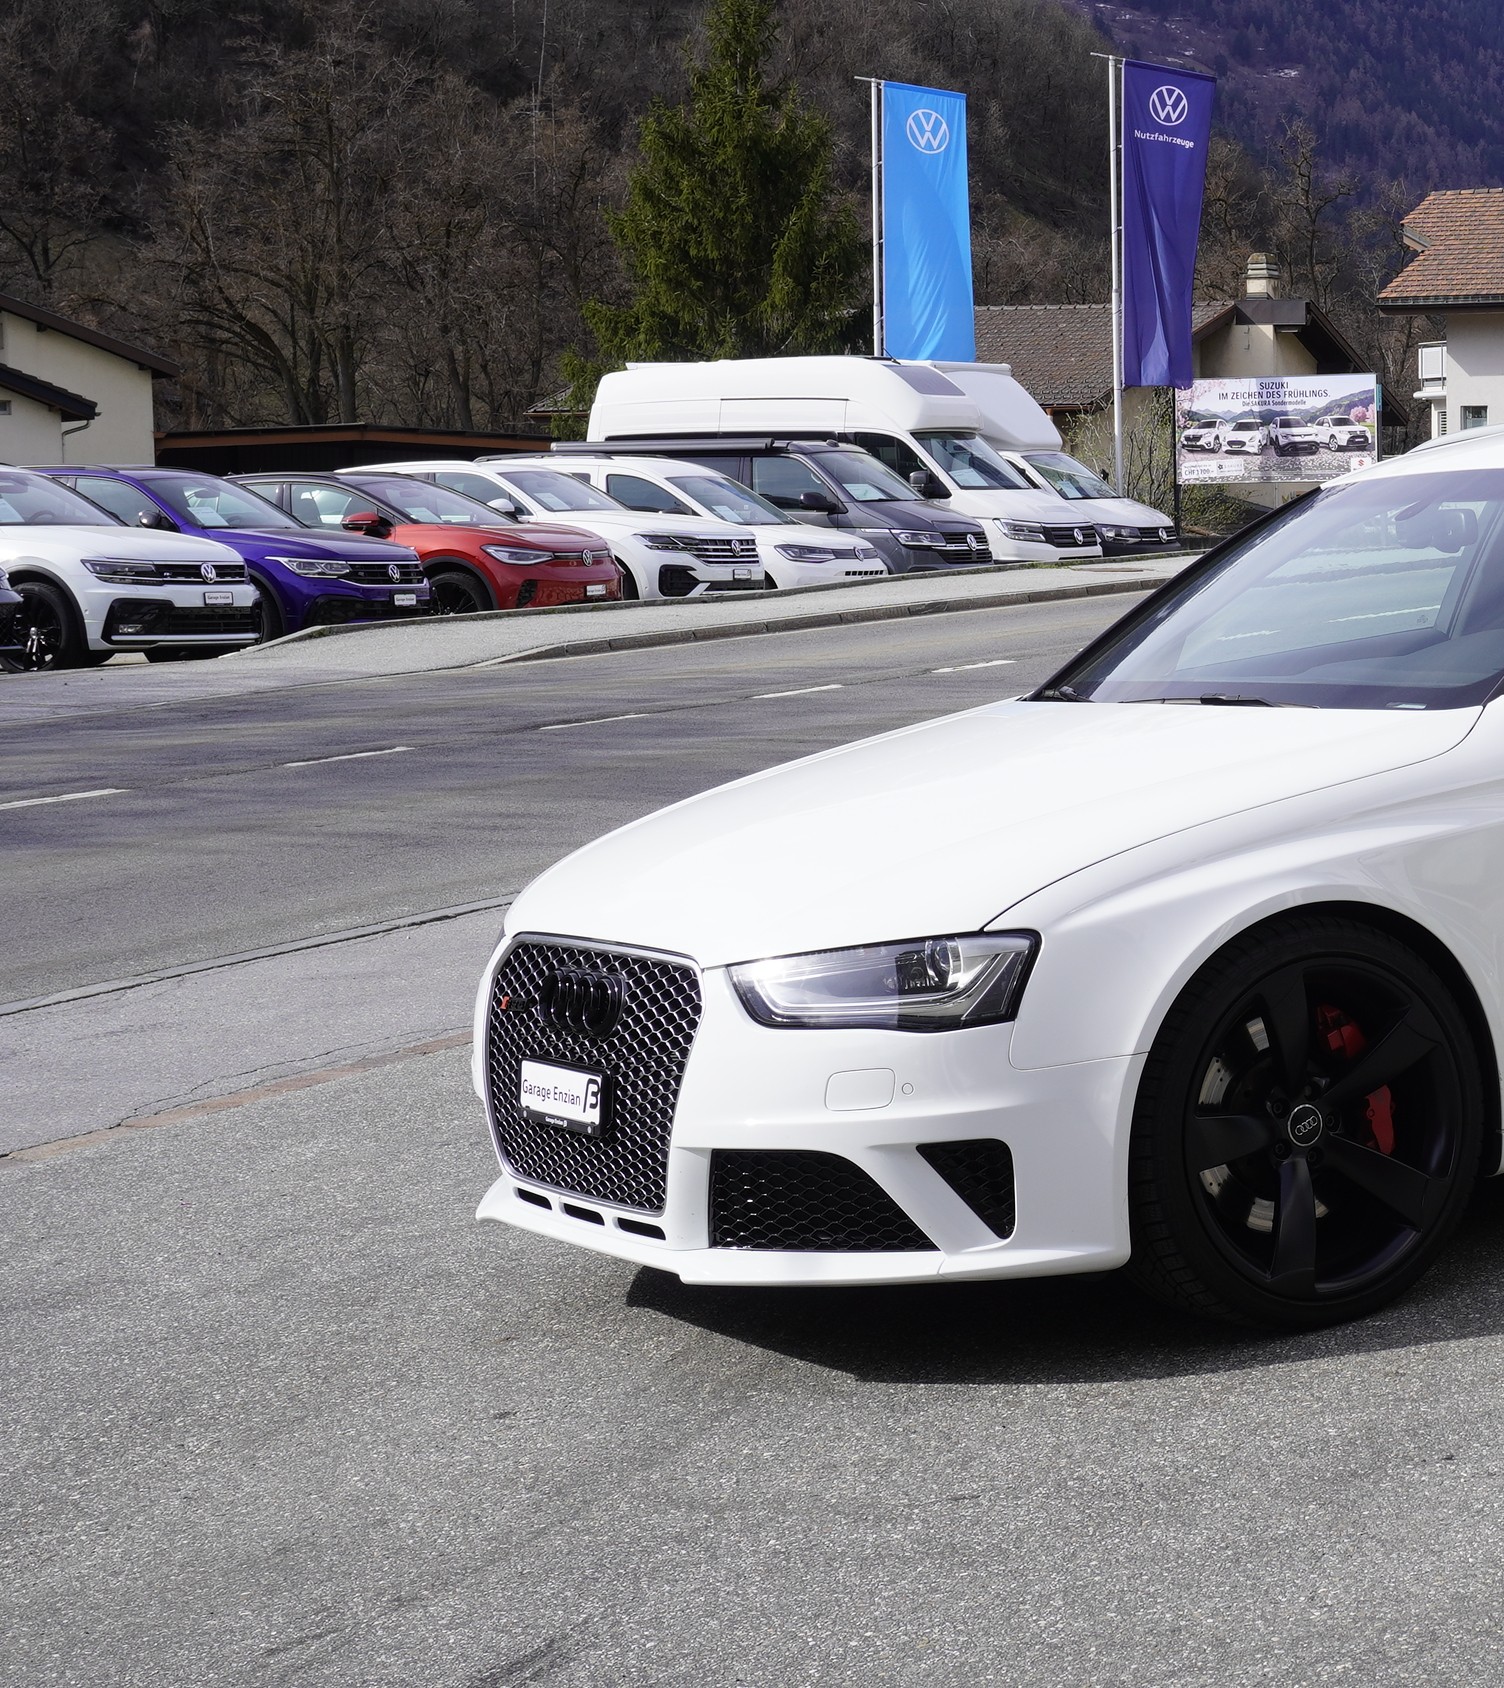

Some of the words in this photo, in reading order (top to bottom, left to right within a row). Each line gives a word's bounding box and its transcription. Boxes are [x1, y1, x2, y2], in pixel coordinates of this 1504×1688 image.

[1134, 129, 1195, 149] Nutzfahrzeuge
[1259, 381, 1289, 390] SUZUKI
[1218, 392, 1229, 400] IM
[1231, 391, 1264, 400] ZEICHEN
[1265, 390, 1281, 399] DES
[1283, 389, 1331, 398] FRÜHLINGS.
[522, 1079, 551, 1102] Garage
[553, 1086, 581, 1106] Enzian
